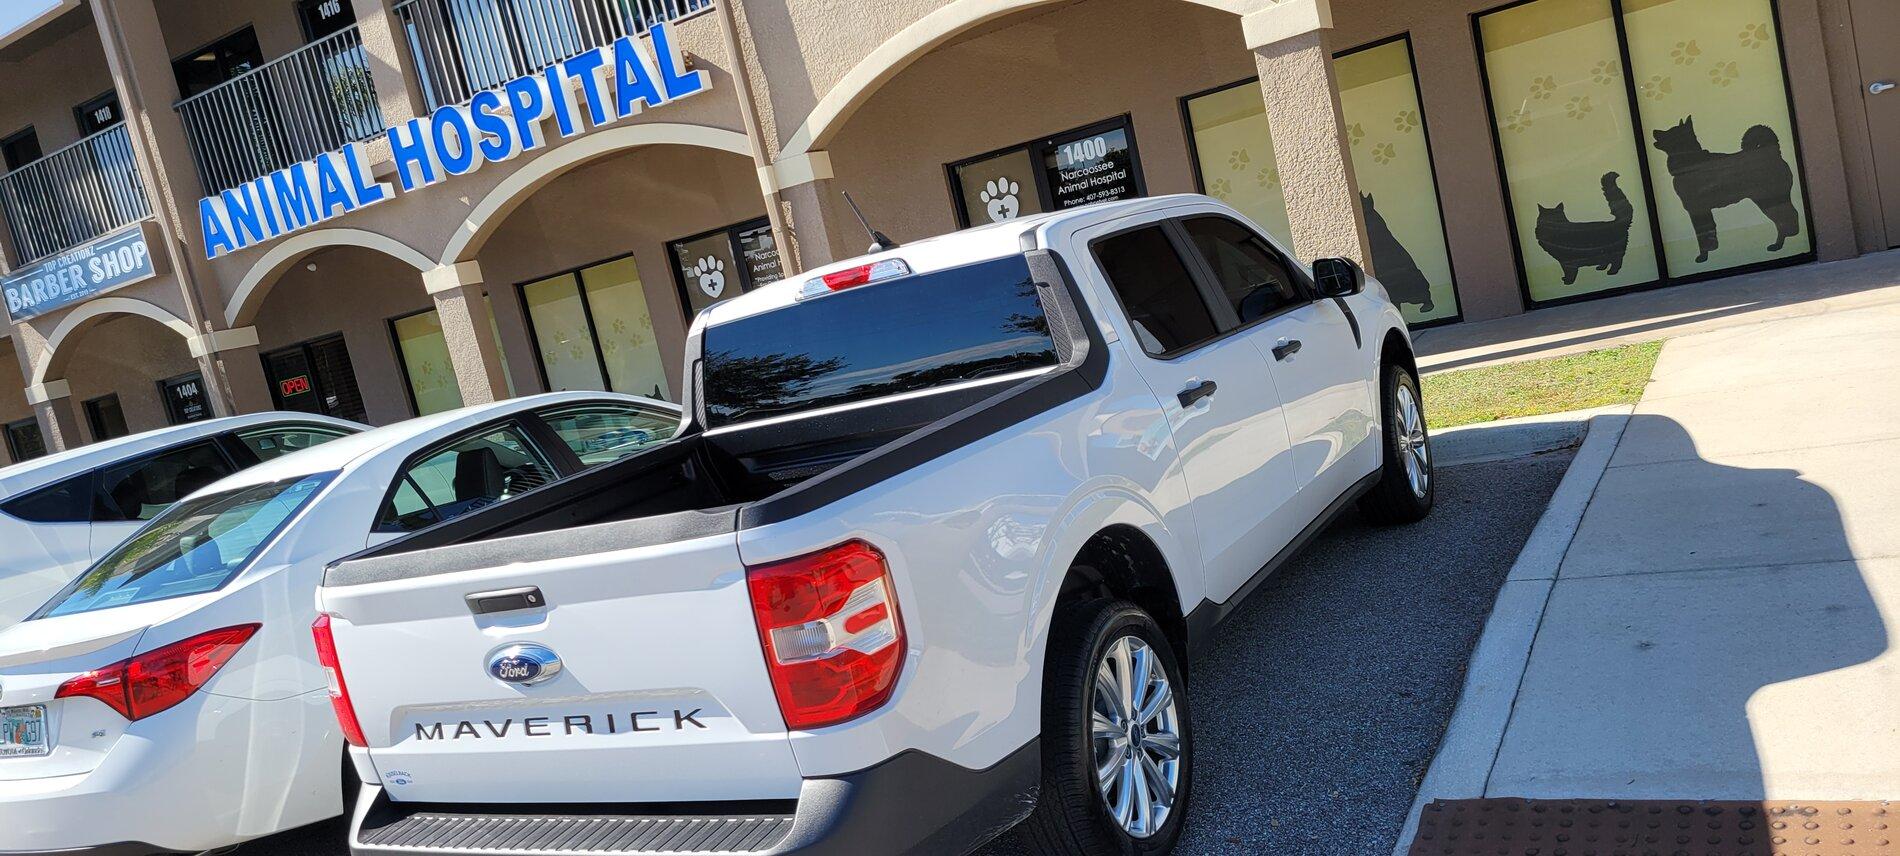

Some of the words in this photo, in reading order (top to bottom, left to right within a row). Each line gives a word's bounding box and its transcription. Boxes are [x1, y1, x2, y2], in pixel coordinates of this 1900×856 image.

[318, 0, 341, 20] 1416
[199, 142, 388, 260] ANIMAL
[386, 21, 704, 193] HOSPITAL
[1064, 137, 1107, 165] 1400
[1058, 179, 1089, 195] Animal
[1089, 168, 1127, 187] Hospital
[1060, 161, 1114, 181] Narcoossee
[1063, 196, 1085, 207] Phone:
[1086, 185, 1126, 201] 407-593-8313
[43, 259, 57, 273] TOP
[58, 245, 96, 266] CREATIONZ
[753, 260, 778, 272] Animal
[5, 264, 88, 314] BARBER
[87, 240, 147, 284] SHOP
[176, 382, 199, 399] 1404
[282, 377, 308, 395] OPEN
[499, 661, 530, 679] Ford
[414, 708, 708, 741] MAVERICK
